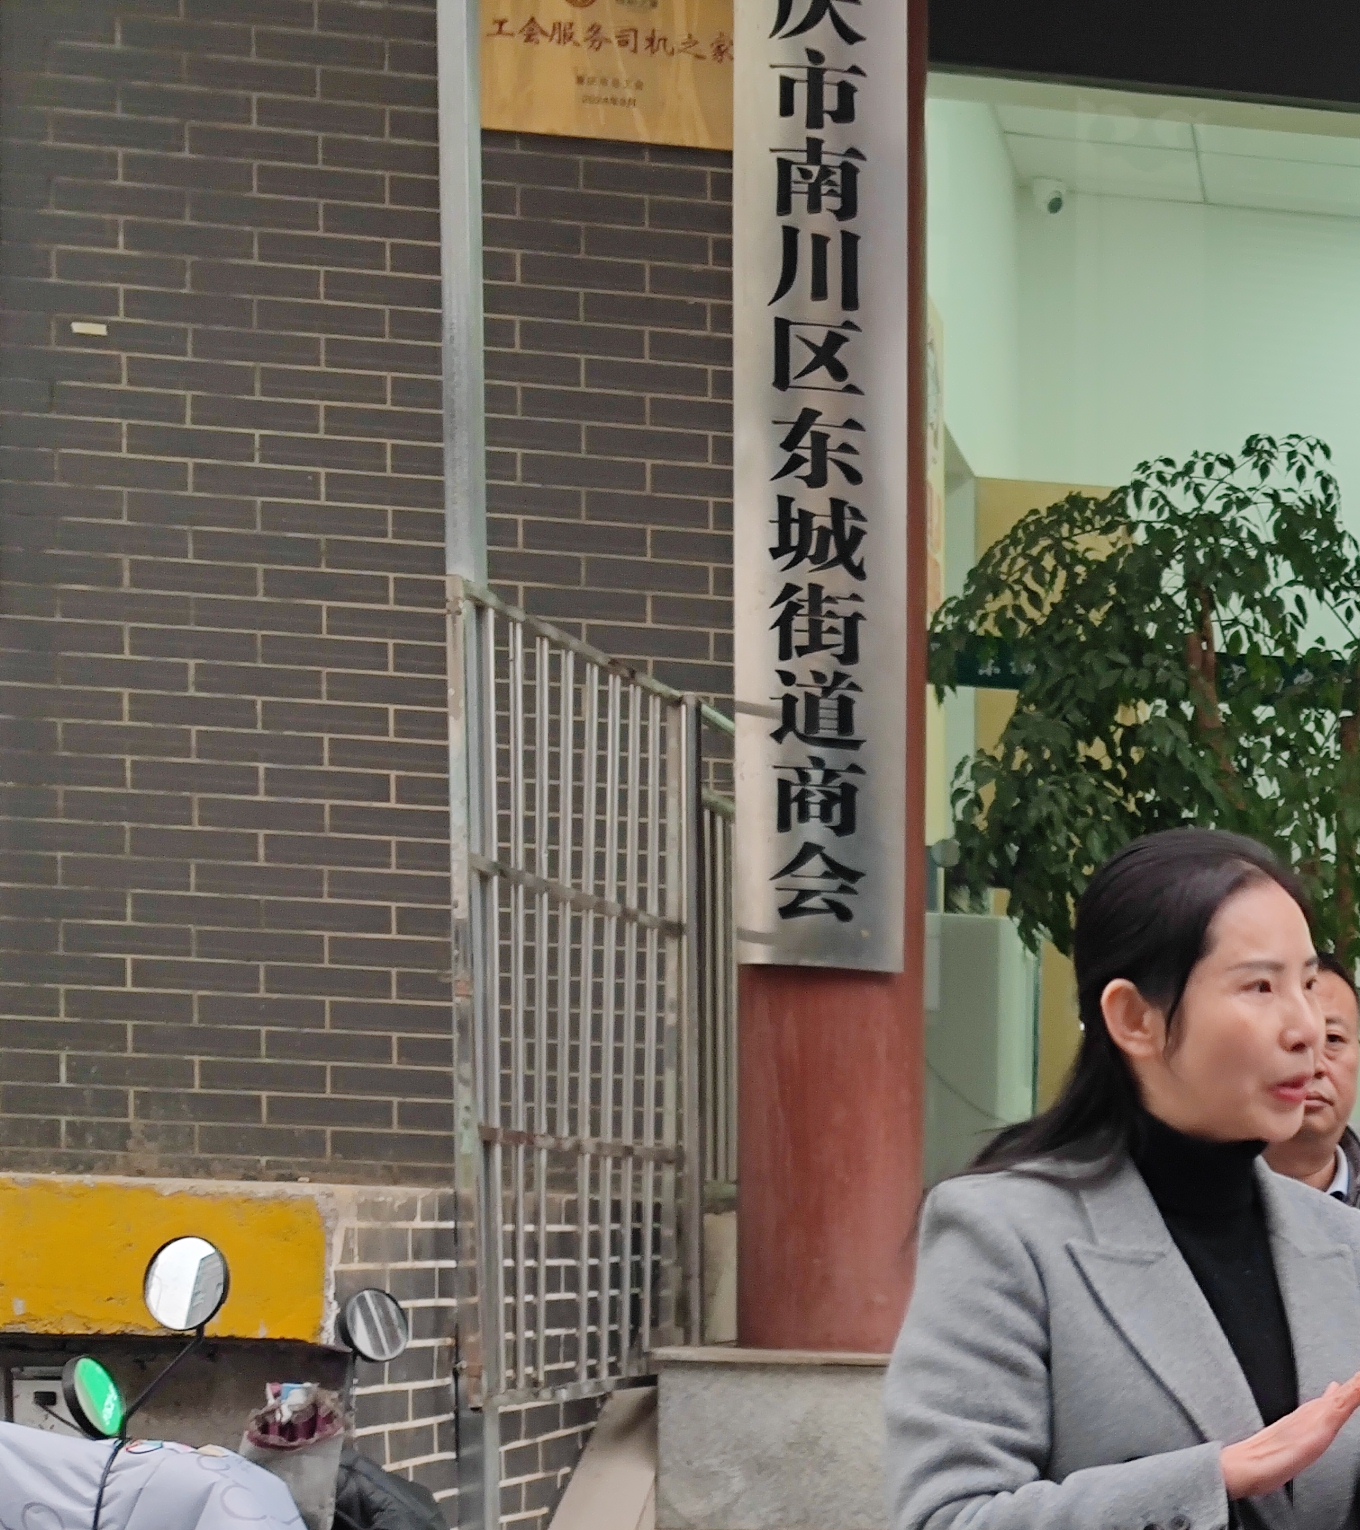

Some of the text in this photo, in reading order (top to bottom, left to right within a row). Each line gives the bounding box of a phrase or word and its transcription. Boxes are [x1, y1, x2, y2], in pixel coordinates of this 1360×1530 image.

[486, 16, 734, 64] 工会服务司机之家
